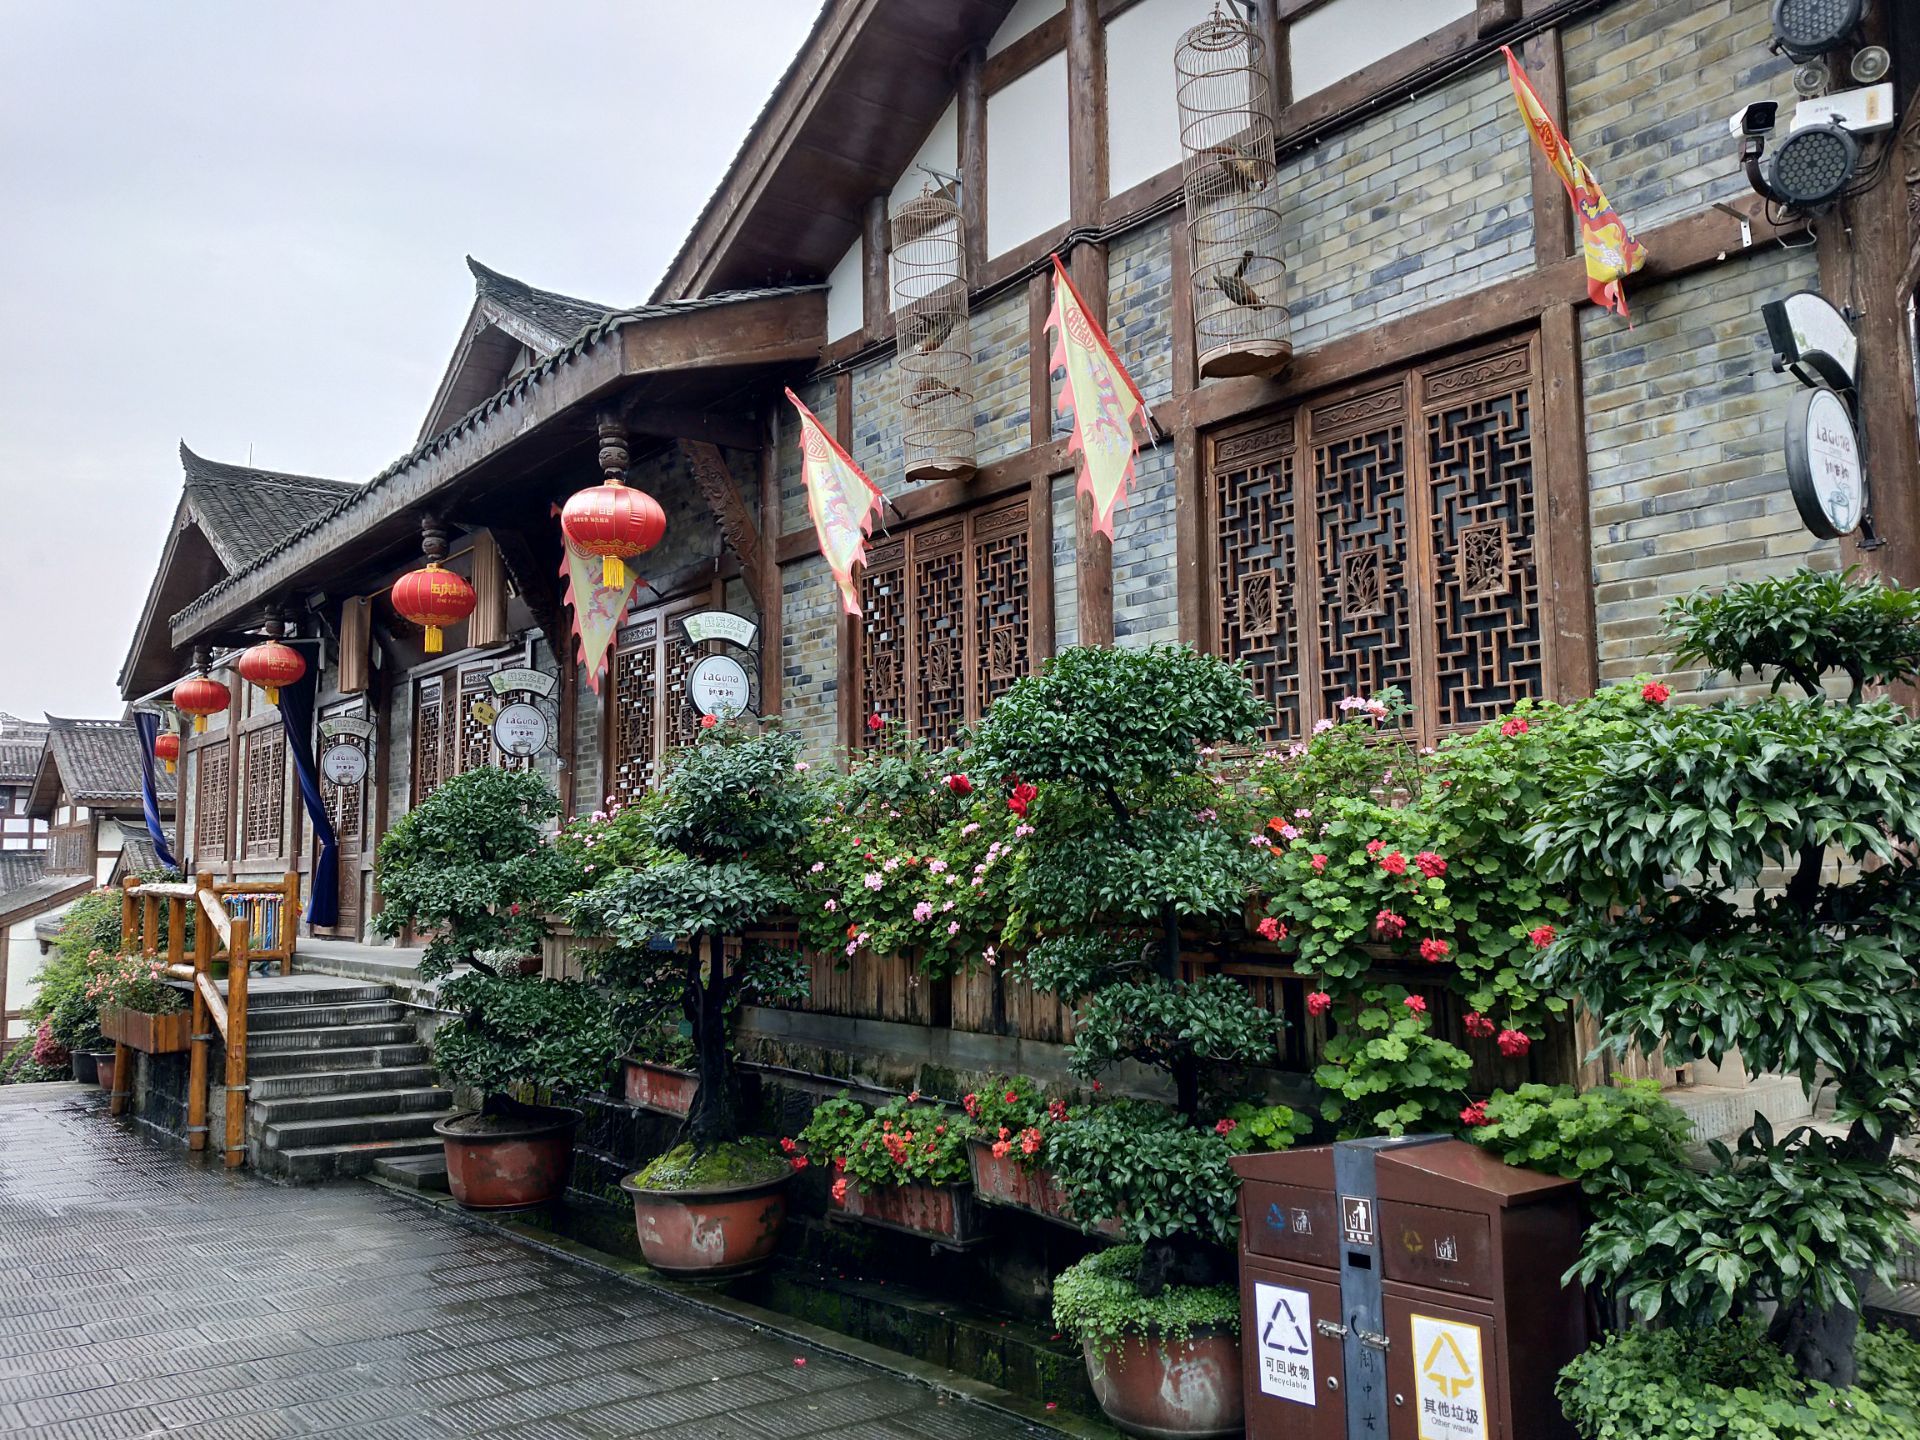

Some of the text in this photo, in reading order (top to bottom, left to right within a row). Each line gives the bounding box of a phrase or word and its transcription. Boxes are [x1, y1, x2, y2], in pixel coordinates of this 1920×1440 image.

[1265, 1356, 1310, 1381] 可回收物
[1269, 1373, 1307, 1390] Recyclable
[1424, 1396, 1479, 1425] 其他垃圾
[1431, 1416, 1474, 1435] Other waste
